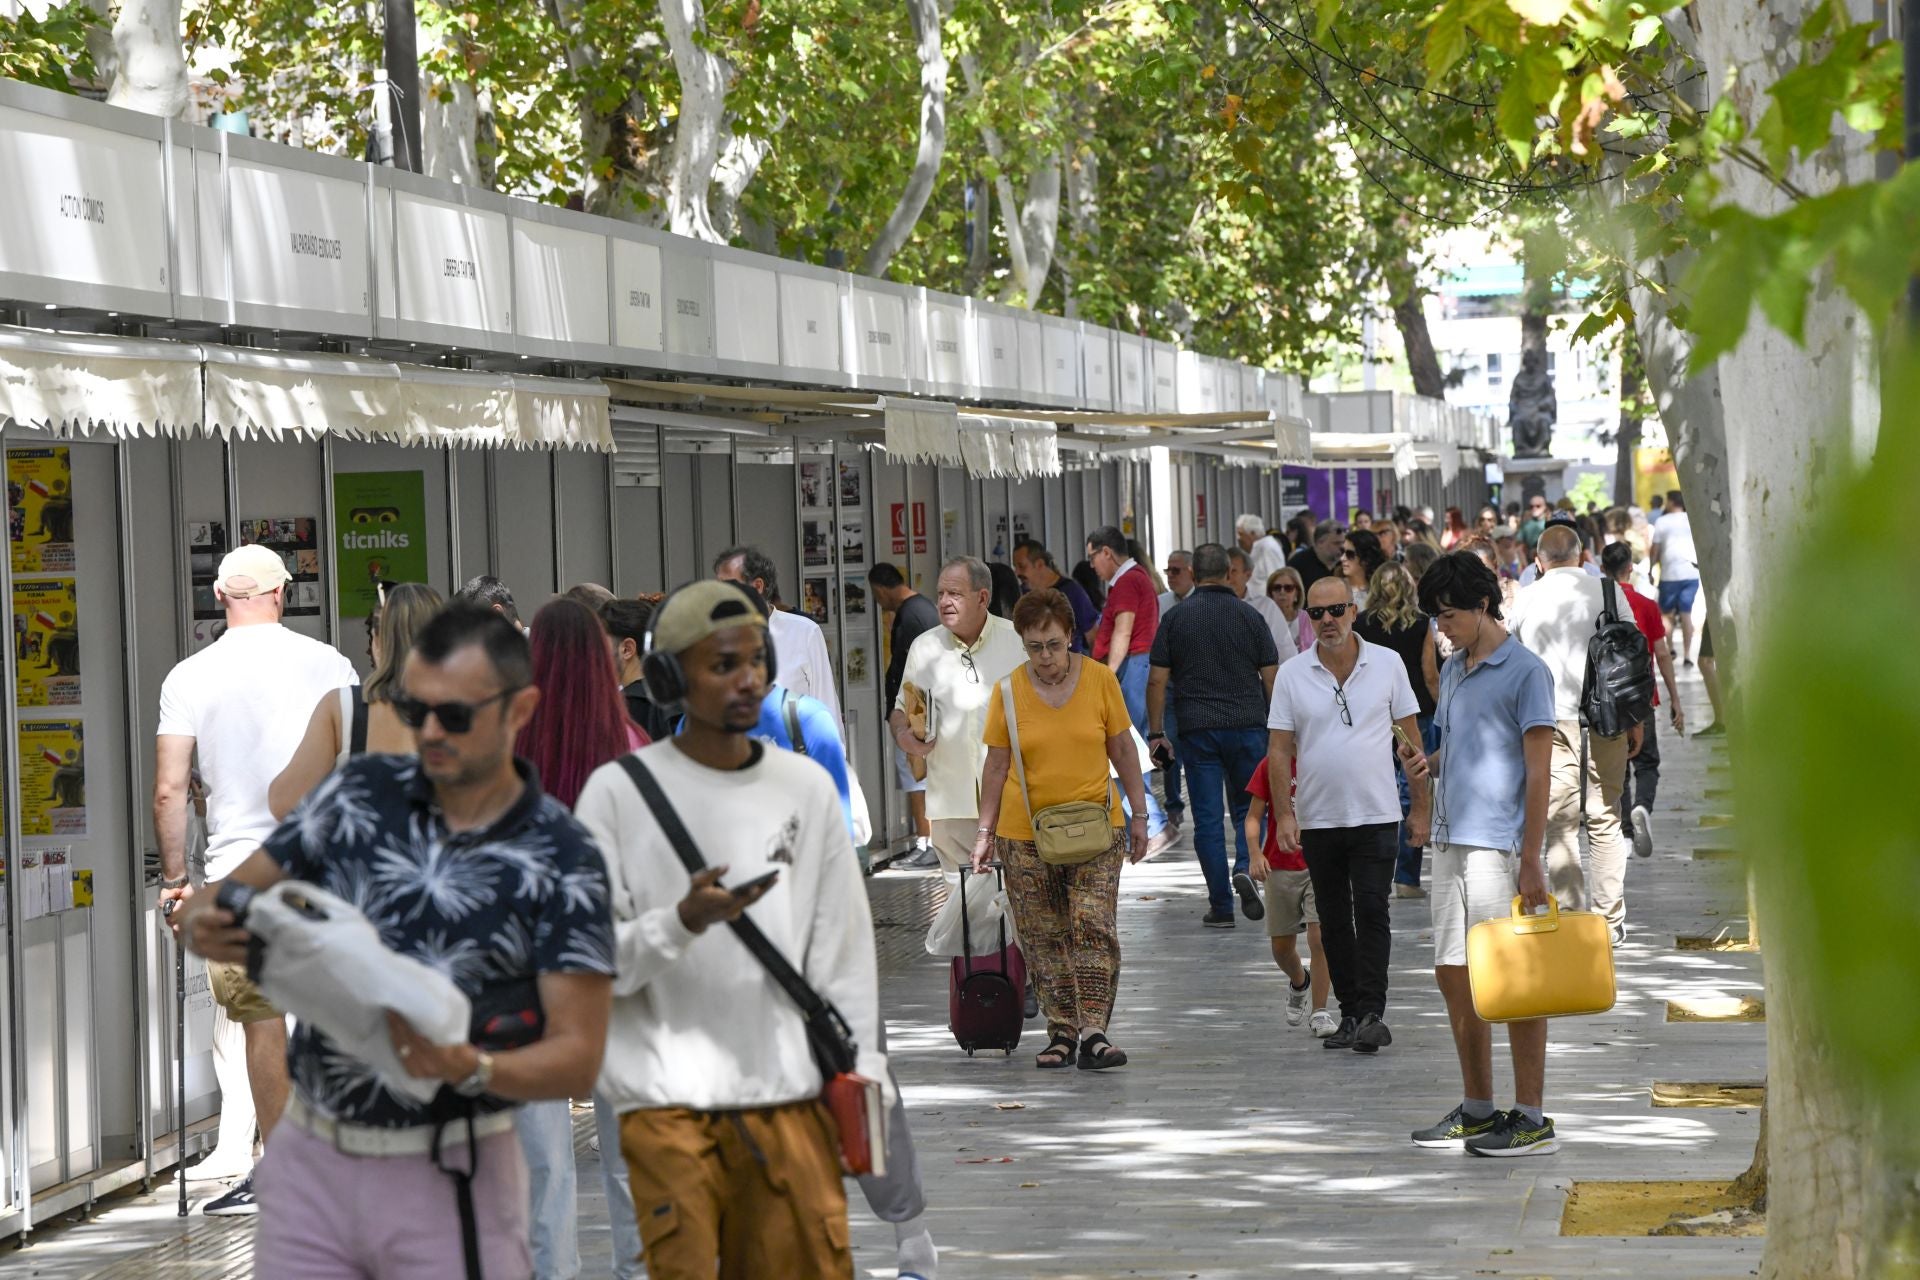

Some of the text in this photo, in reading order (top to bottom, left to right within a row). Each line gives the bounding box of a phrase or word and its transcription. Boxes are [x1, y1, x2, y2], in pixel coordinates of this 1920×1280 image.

[60, 194, 81, 219] ACTION
[318, 237, 342, 260] EDICIONES
[342, 529, 409, 550] ticniks
